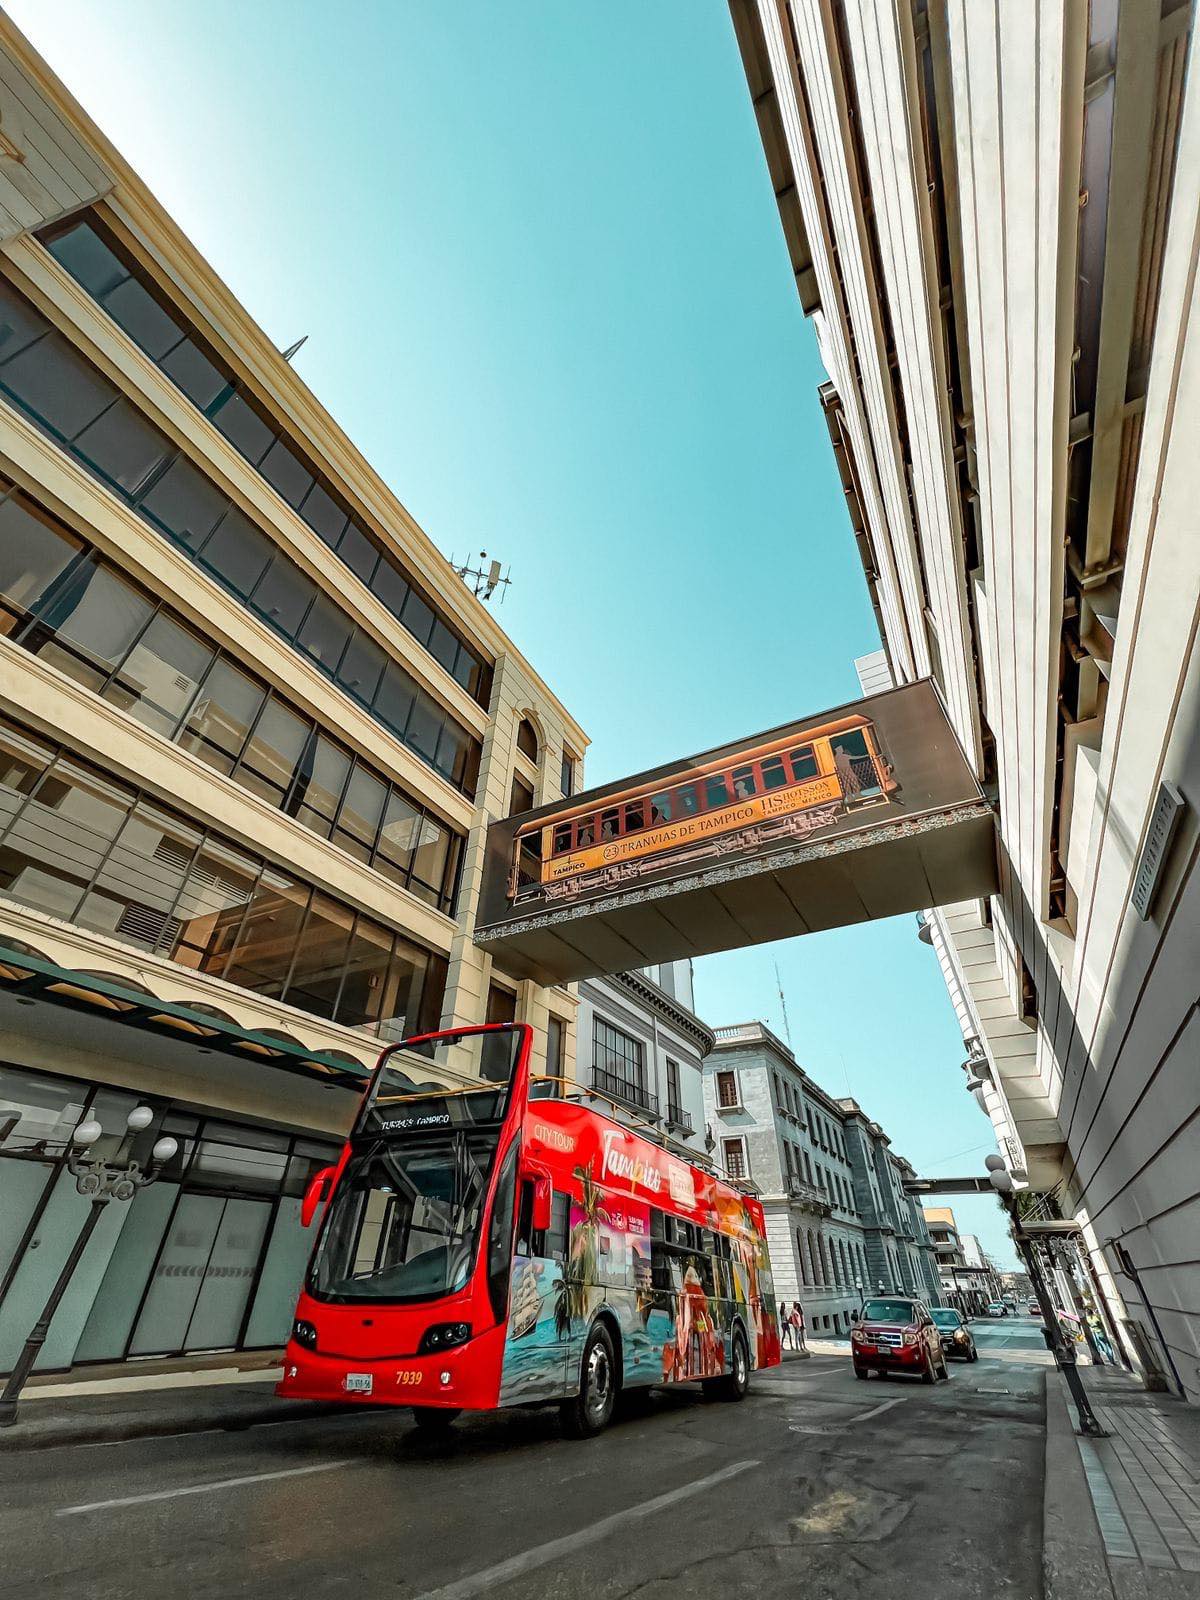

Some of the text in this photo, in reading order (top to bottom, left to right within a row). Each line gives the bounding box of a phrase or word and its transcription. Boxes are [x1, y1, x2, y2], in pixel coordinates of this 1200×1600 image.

[762, 802, 796, 816] TAMPICO
[620, 829, 678, 854] TRANVIAS
[679, 825, 696, 837] DE
[698, 807, 754, 831] TAMPICO
[553, 862, 586, 876] TAMPICO
[534, 1124, 575, 1152] CITY TOUR
[601, 1129, 662, 1197] Tampico
[395, 1371, 423, 1385] 7939
